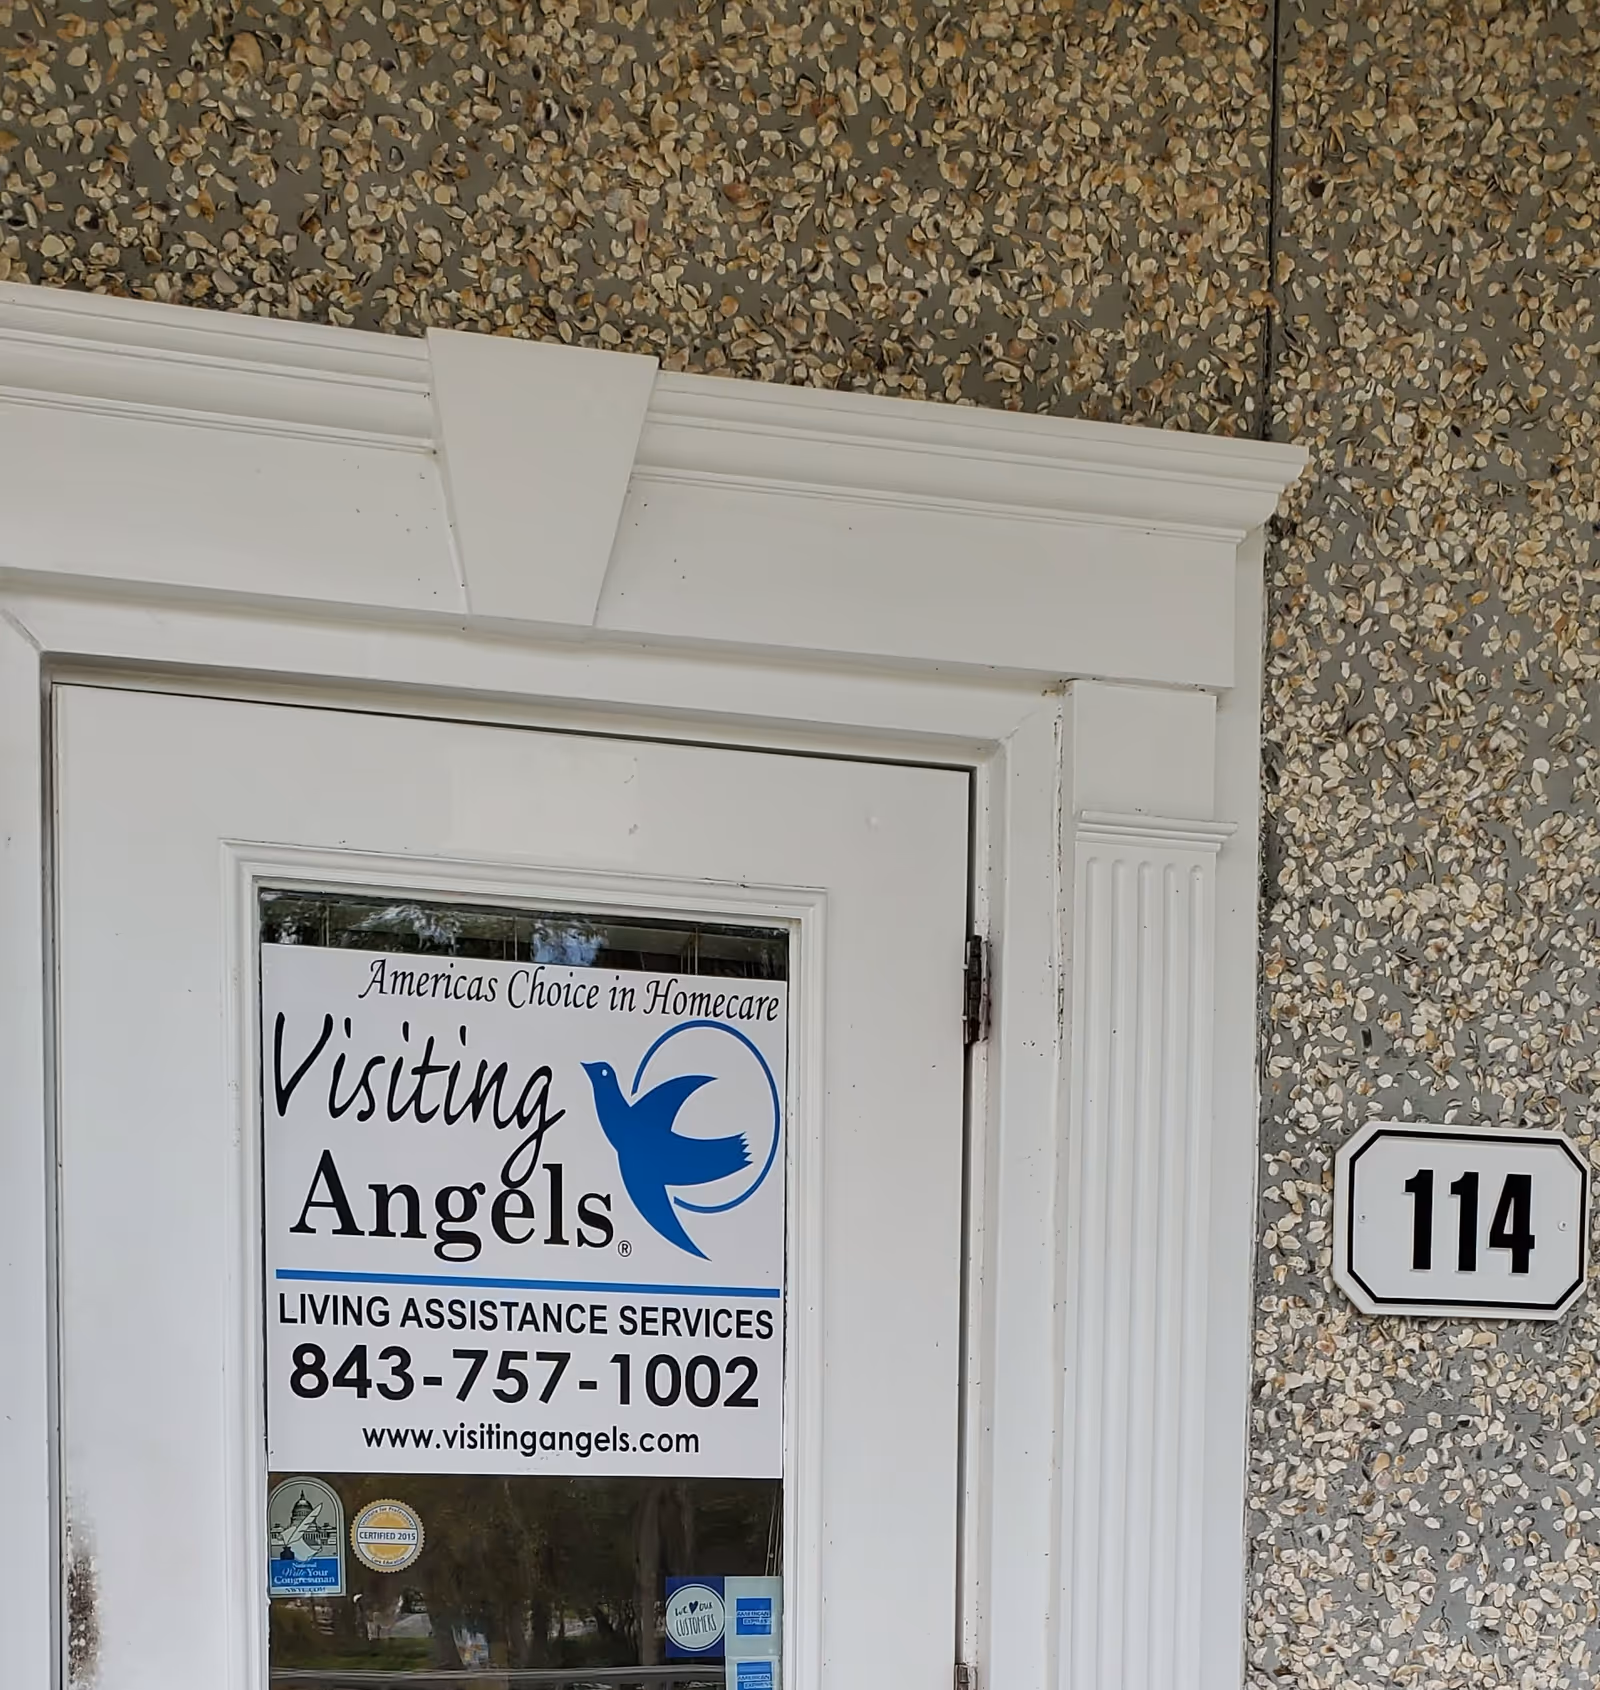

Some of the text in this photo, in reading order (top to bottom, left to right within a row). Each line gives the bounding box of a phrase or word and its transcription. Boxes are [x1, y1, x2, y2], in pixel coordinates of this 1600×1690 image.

[358, 958, 779, 1021] Americas Choice in Homecare
[274, 1011, 566, 1189] Visiting
[1404, 1168, 1536, 1274] 114
[278, 1293, 775, 1340] LIVING ASSISTANCE SERVICES
[289, 1342, 760, 1408] 843-757-1002
[362, 1423, 700, 1458] www.visitingangels.com
[359, 1531, 416, 1540] CERTIFIED 2015
[274, 1576, 335, 1585] Congressman
[307, 1568, 328, 1577] Your
[675, 1613, 717, 1638] CUSTOMERS
